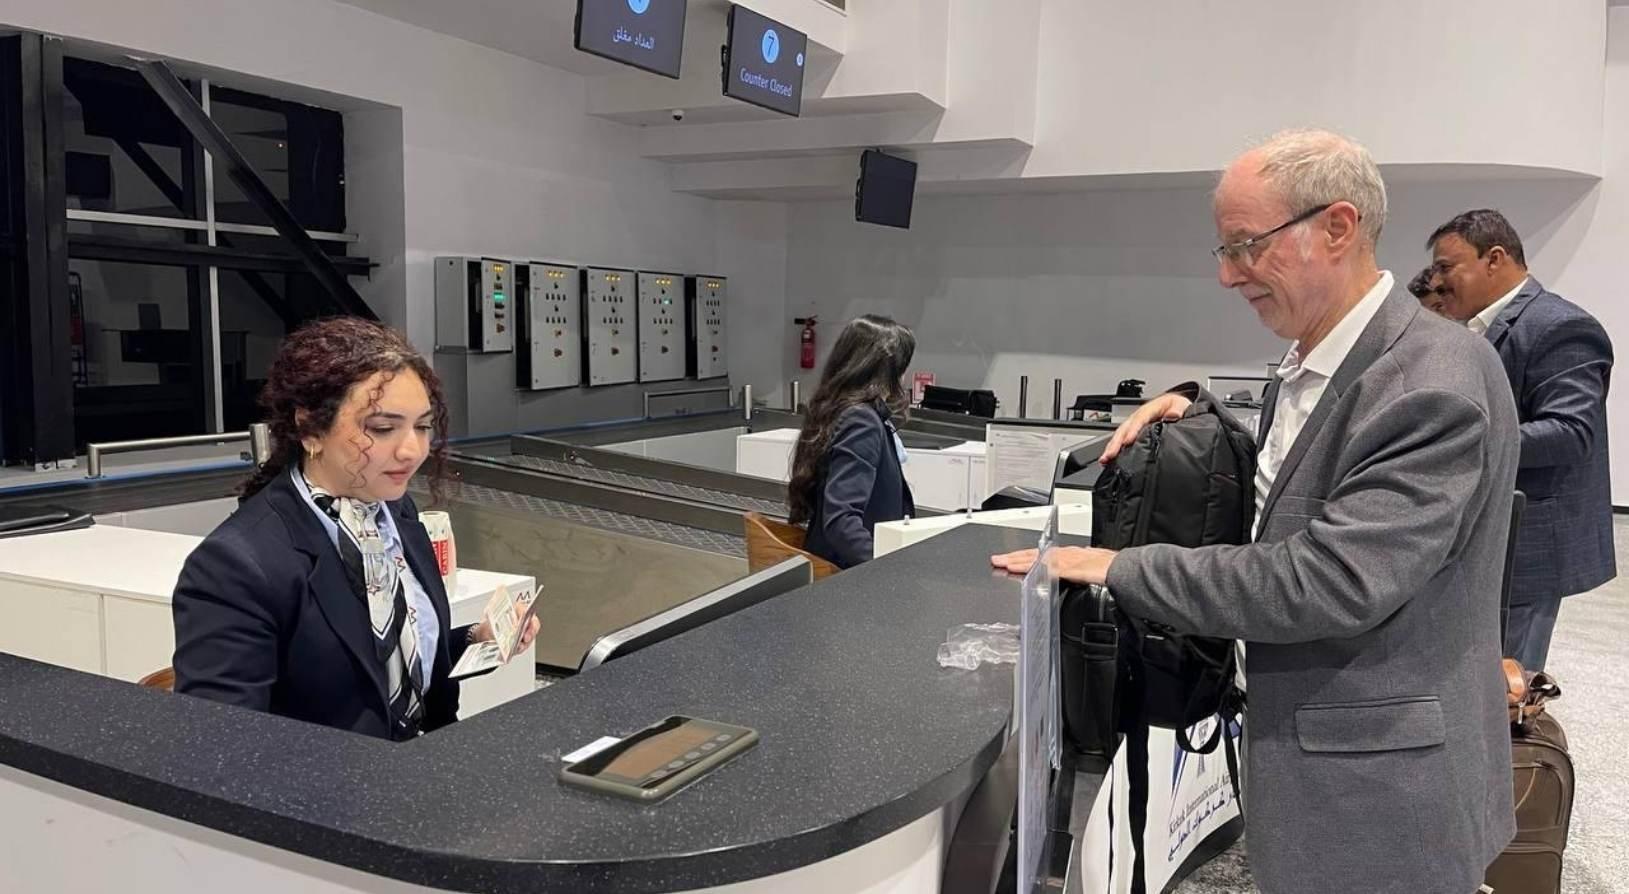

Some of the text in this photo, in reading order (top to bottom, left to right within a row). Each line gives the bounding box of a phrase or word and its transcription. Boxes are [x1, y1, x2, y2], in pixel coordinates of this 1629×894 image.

[612, 26, 632, 43] مغلق
[768, 35, 775, 57] 7
[740, 67, 792, 96] Counter Closed
[1185, 776, 1220, 817] International
